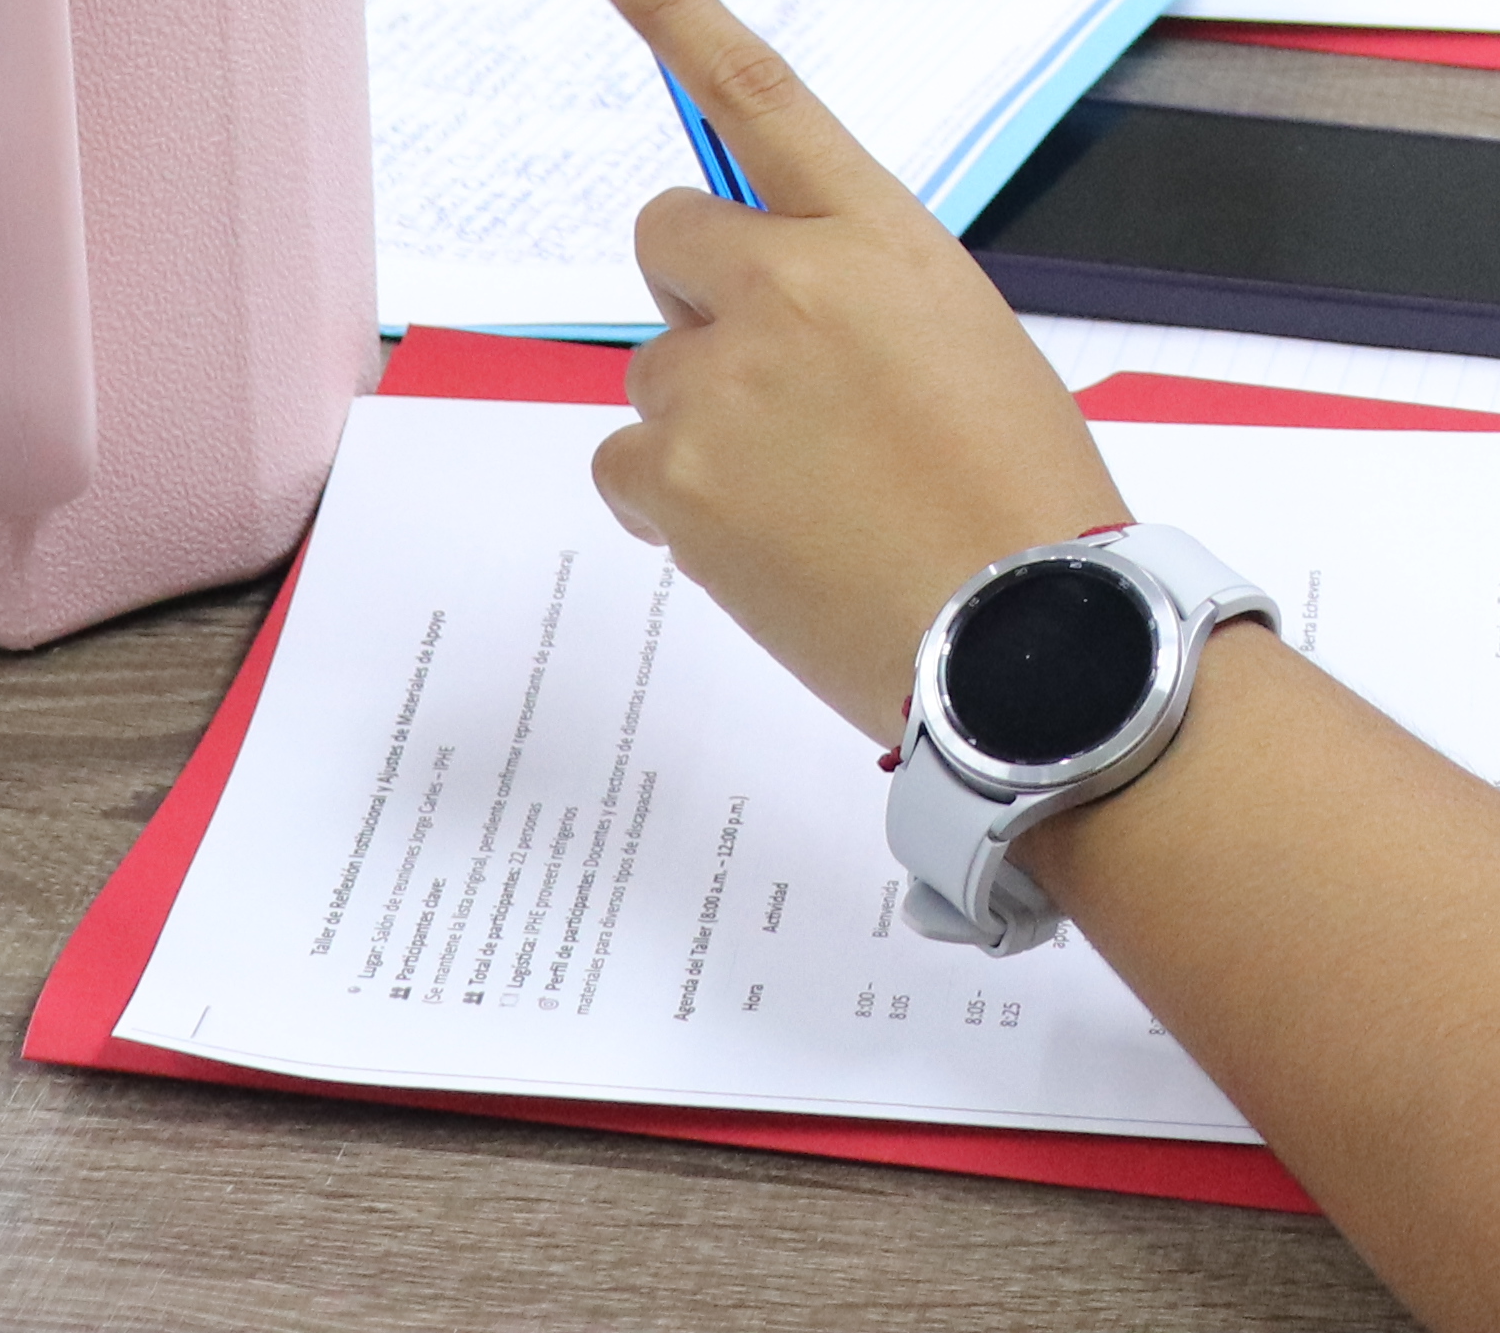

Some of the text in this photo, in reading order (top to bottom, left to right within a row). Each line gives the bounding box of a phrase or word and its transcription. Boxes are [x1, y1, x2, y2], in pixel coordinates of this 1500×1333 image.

[420, 610, 446, 647] Apoyo
[1299, 622, 1317, 652] Berta
[415, 649, 434, 664] de
[395, 666, 429, 725] Materiales
[390, 728, 410, 742] de
[376, 744, 404, 784] Ajustes
[432, 745, 455, 770] IPHE
[421, 549, 578, 1004] (Se mantiene la lista original, pendiente confirmar representante de parálisis cerebral)
[544, 566, 674, 991] Perfil de participantes: Docentes y directores de distintas escuelas del IPHE que
[727, 795, 749, 825] p.m.)
[348, 794, 387, 858] Institucional
[407, 815, 433, 844] Jorge
[716, 826, 738, 857] 12:00
[328, 860, 362, 909] Reflexión
[391, 844, 421, 896] reuniones
[709, 869, 727, 894] a.m.
[382, 897, 402, 912] de
[467, 802, 542, 985] Total de participantes: 22 personas
[506, 806, 578, 988] Logística: IPHE proveerá refrigerios
[576, 770, 657, 1015] materiales para diversos tipos de discapacidad
[761, 882, 788, 933] Actividad
[323, 910, 343, 924] de
[697, 895, 720, 923] (8:00
[871, 879, 899, 938] Bienvenida
[309, 926, 336, 955] Taller
[370, 913, 396, 943] Salón
[394, 877, 446, 980] Participantes clave:
[689, 925, 712, 955] Taller
[357, 945, 384, 978] Lugar:
[684, 957, 703, 975] del
[673, 978, 699, 1021] Agenda
[741, 984, 763, 1011] Hora
[854, 991, 875, 1018] 8:00
[888, 994, 910, 1020] 8:05
[964, 999, 986, 1025] 8:05
[999, 1002, 1021, 1027] 8:25
